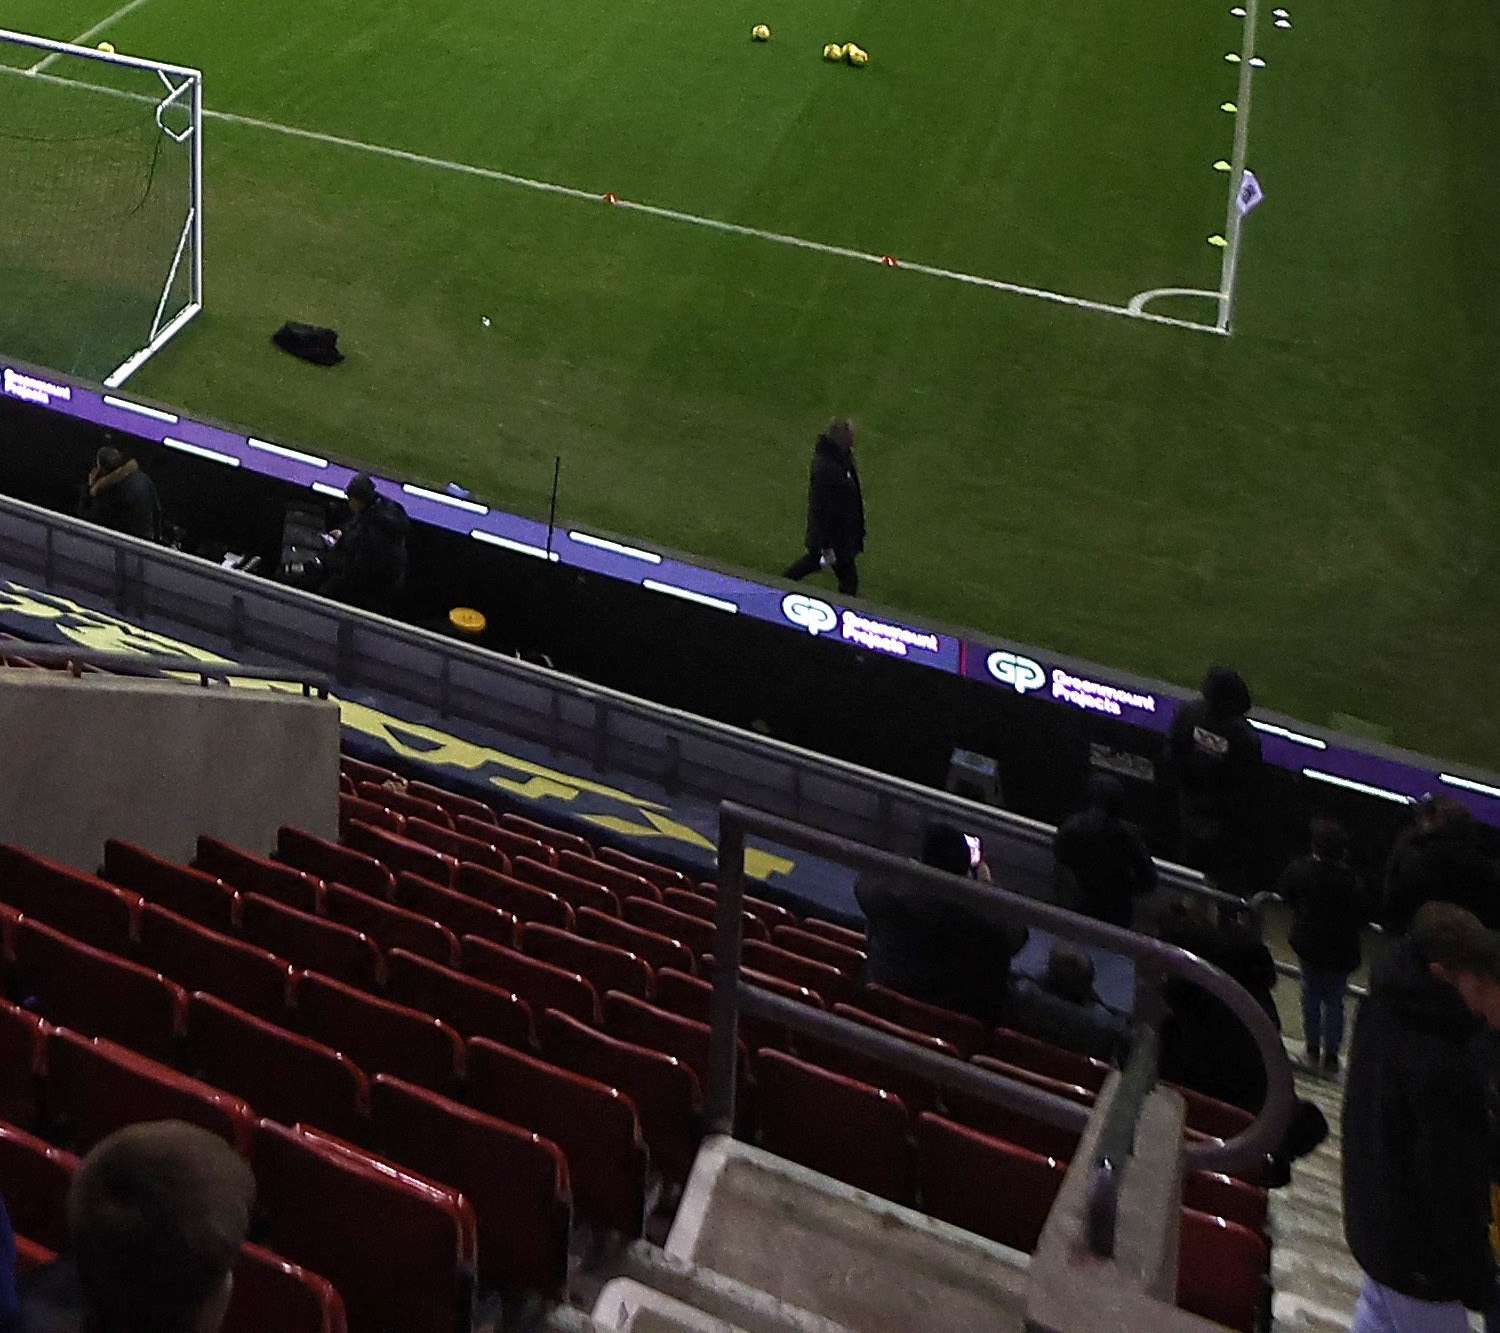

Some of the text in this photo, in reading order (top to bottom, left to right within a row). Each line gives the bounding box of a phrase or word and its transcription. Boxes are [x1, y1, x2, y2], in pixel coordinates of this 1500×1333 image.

[842, 610, 940, 653] Greenmount
[842, 623, 908, 656] Projects
[1052, 668, 1155, 712] Greenmount
[1052, 681, 1122, 716] Projects
